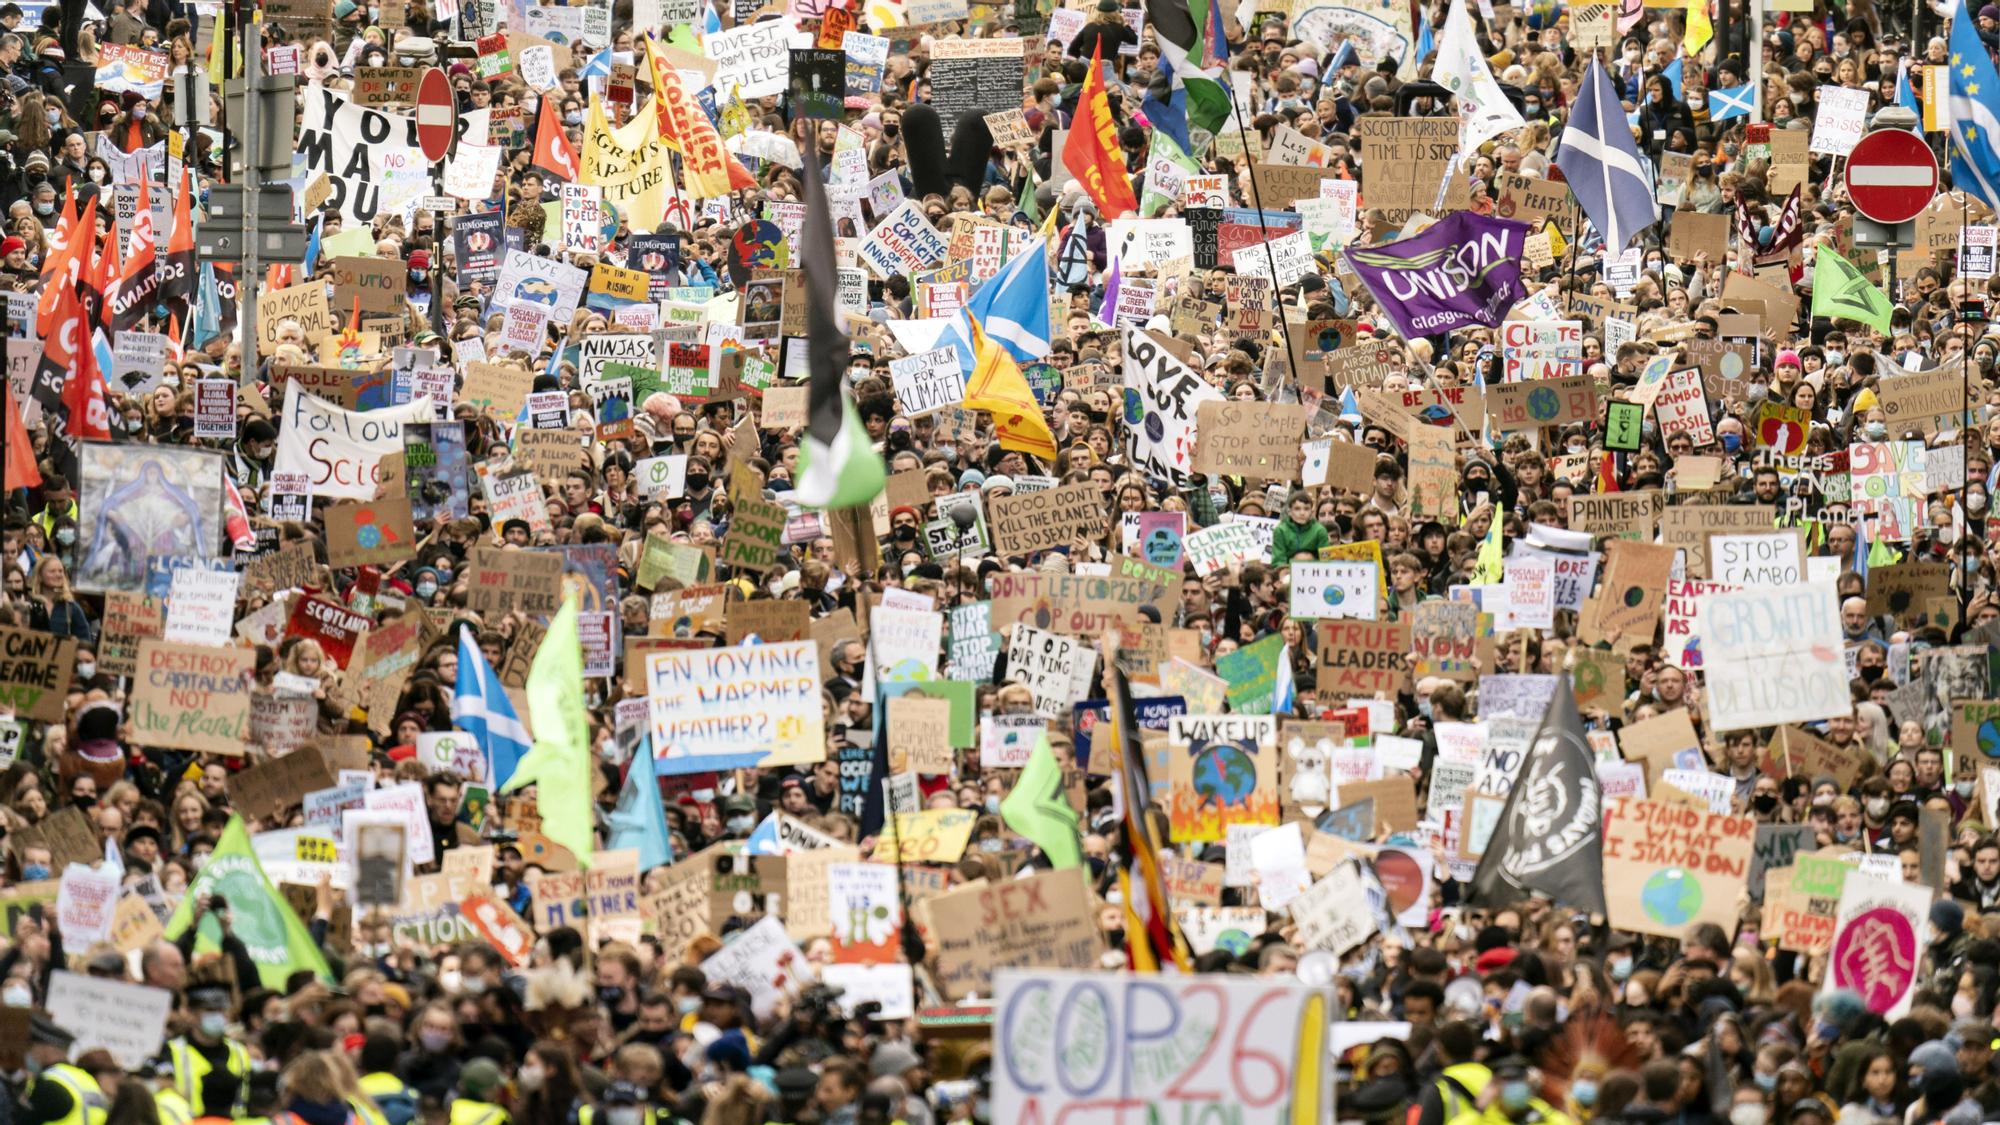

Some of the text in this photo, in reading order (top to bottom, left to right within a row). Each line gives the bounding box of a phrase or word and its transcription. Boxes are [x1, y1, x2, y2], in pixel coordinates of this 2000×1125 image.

[662, 8, 697, 20] ACT NOW
[712, 25, 780, 56] DIVEST
[102, 44, 120, 57] WE
[124, 49, 148, 64] MUST
[360, 69, 413, 78] WE WANT TO
[720, 60, 789, 91] FUELS
[362, 82, 414, 91] DIE OF
[368, 94, 390, 102] OLD
[1363, 120, 1459, 137] SCOTT MORRISO
[1370, 144, 1401, 160] TIME
[1405, 144, 1426, 160] TO
[1187, 178, 1222, 191] TIME
[1507, 176, 1532, 189] FOR
[566, 187, 588, 196] END
[1187, 192, 1206, 204] HAS
[566, 209, 598, 222] FUELS
[901, 209, 920, 228] NO
[888, 252, 901, 265] OF
[1381, 228, 1510, 301] UNISON
[1121, 288, 1154, 298] SOCIALIST
[1254, 288, 1265, 300] TO
[262, 289, 318, 316] NO MORE
[1118, 305, 1150, 316] NEW DEAL
[1126, 298, 1146, 307] GREEN
[509, 307, 546, 320] SOCIALIST
[584, 338, 647, 356] NINJAS
[668, 376, 708, 387] CLIMATE
[669, 368, 694, 378] FUND
[914, 370, 936, 382] FOR
[1077, 376, 1089, 385] NO
[203, 391, 228, 399] GLOBAL
[668, 385, 693, 395] JOBS
[1656, 389, 1701, 407] CAMBO
[1402, 391, 1423, 407] BE
[198, 423, 233, 431] TOGETHER
[1662, 416, 1709, 435] FOSSIL
[1852, 443, 1925, 475] SAVE
[1051, 503, 1100, 525] PLANET
[1573, 500, 1649, 522] PAINTERS
[1671, 511, 1691, 524] IF
[1744, 512, 1773, 525] STILL
[1723, 539, 1788, 565] STOP
[1725, 564, 1798, 585] CAMBO
[1708, 592, 1830, 646] GROWTH
[320, 623, 344, 640] 2050
[1325, 623, 1402, 649] TRUE
[150, 651, 239, 673] DESTROY
[1323, 649, 1410, 669] LEADERS
[1, 664, 59, 689] EATHE
[170, 690, 212, 709] NOT
[1177, 720, 1270, 742] WAKE UP
[1486, 749, 1521, 773] NO
[1614, 799, 1754, 838] I STAND FOR
[1646, 826, 1721, 848] WHAT
[1606, 837, 1746, 878] I STAND ON
[978, 879, 1047, 925] SEX
[1004, 979, 1290, 1106] COP26
